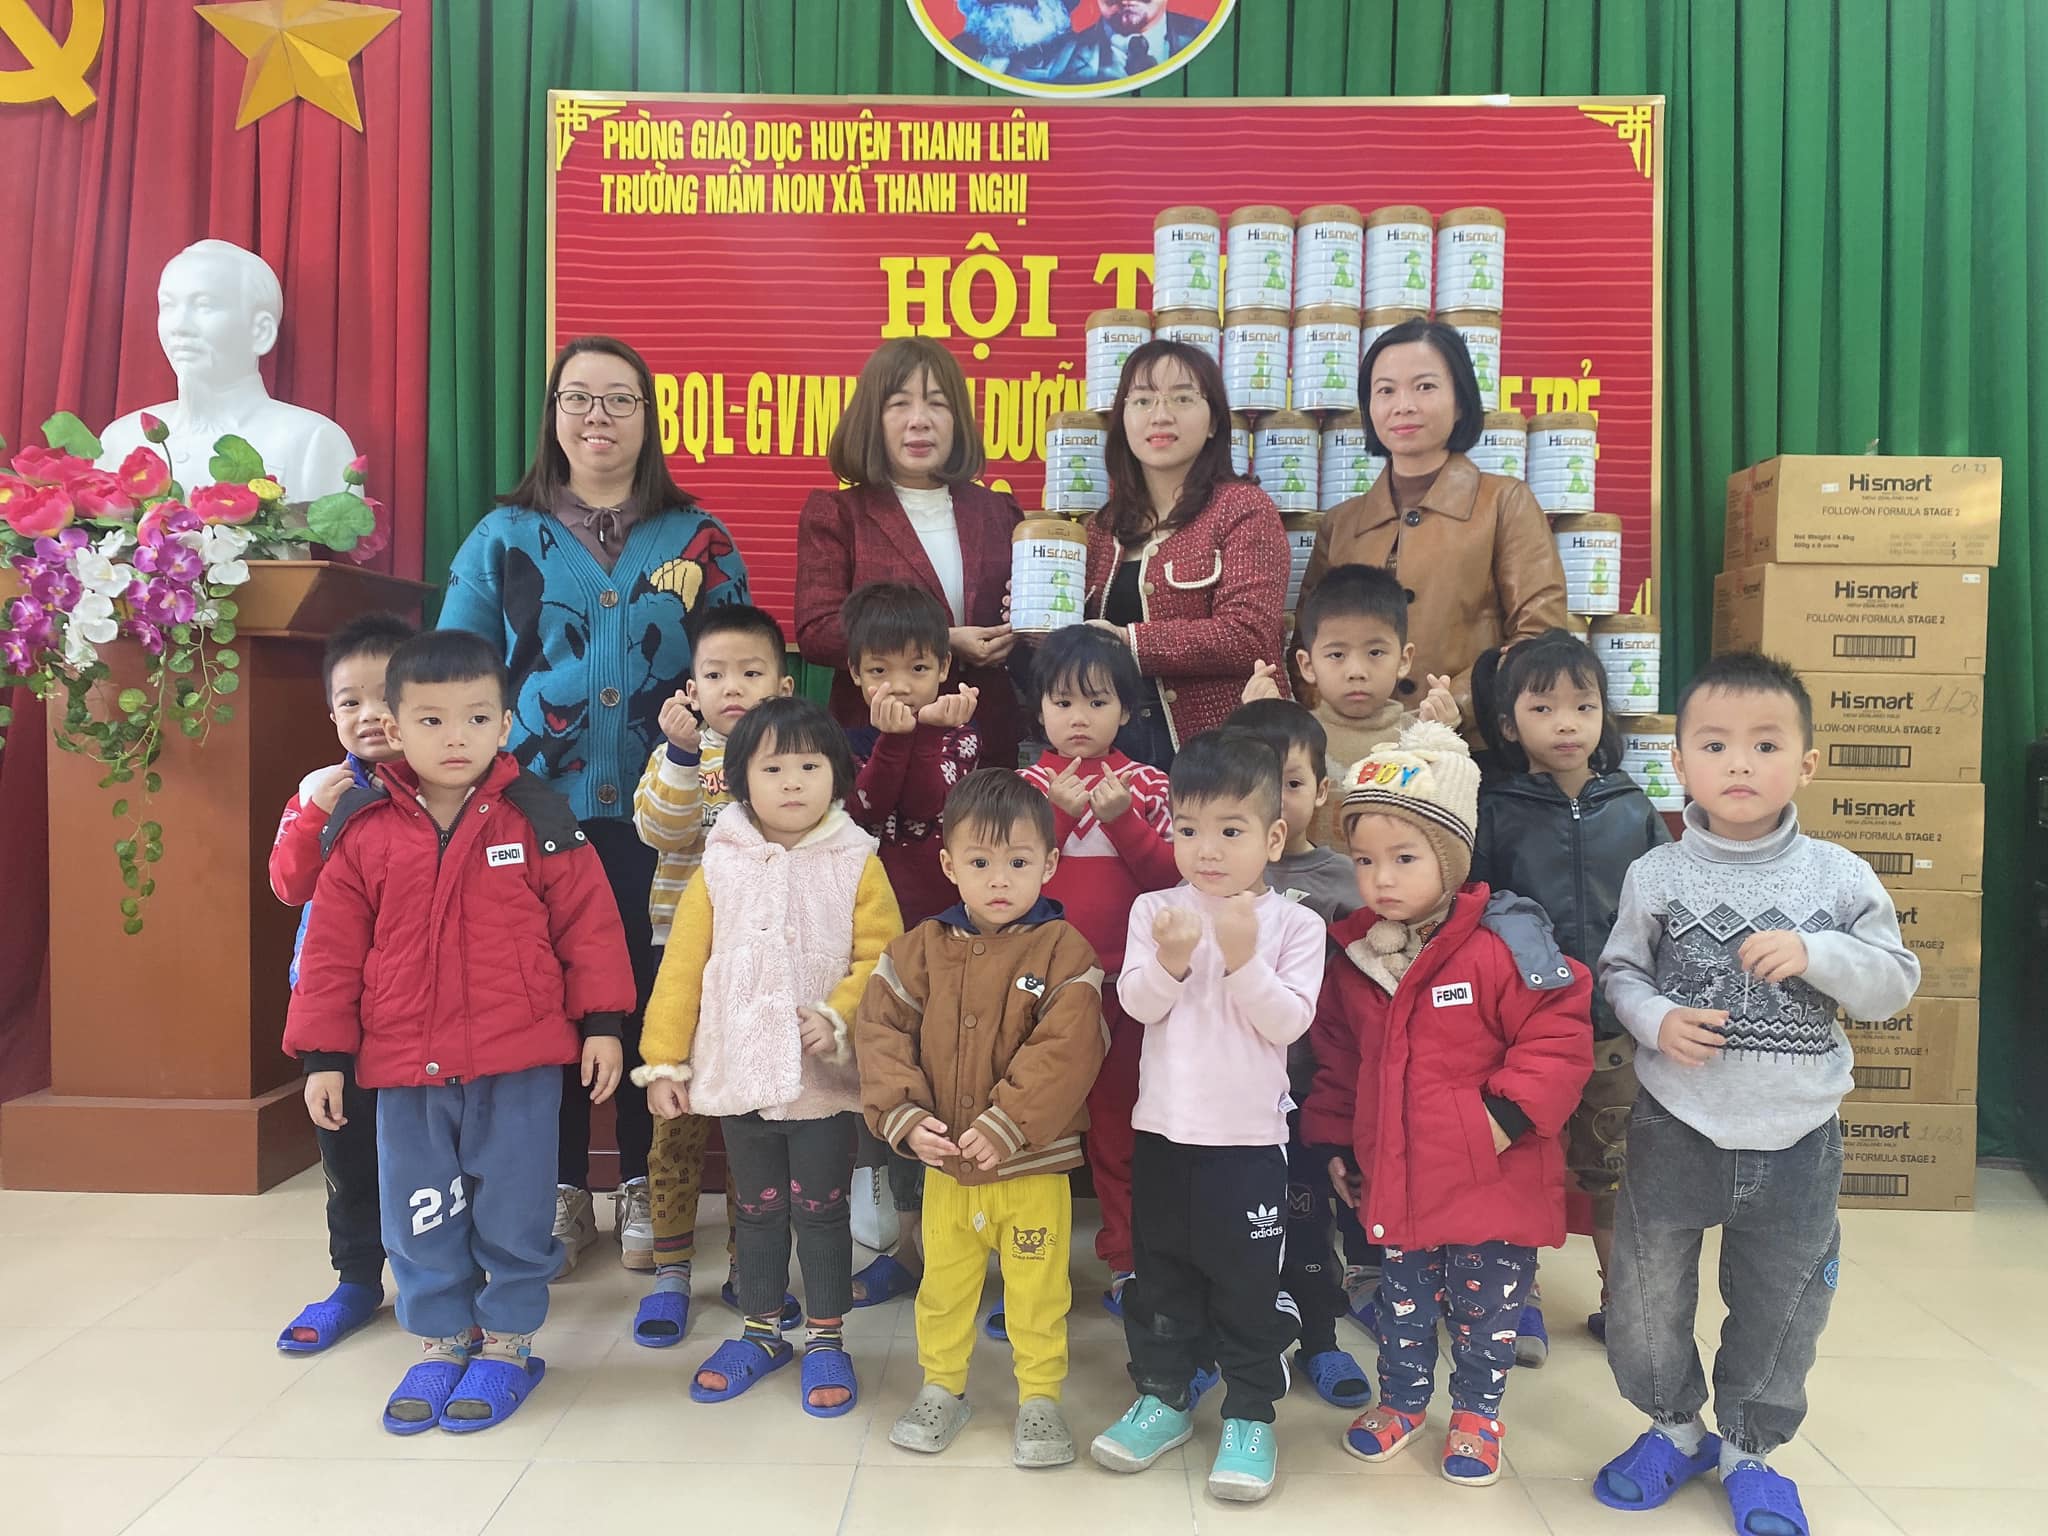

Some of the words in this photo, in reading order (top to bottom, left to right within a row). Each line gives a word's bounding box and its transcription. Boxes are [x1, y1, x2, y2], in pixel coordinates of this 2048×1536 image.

[603, 108, 684, 160] PHÒNG
[691, 110, 747, 160] GIÁO
[754, 121, 803, 169] DỤC
[811, 108, 891, 169] HUYỆN
[898, 121, 981, 161] THANH
[989, 107, 1049, 161] LIÊM
[600, 160, 699, 214] TRƯỜNG
[772, 174, 825, 214] NON
[830, 163, 866, 213] XÃ
[873, 173, 956, 213] THANH
[968, 173, 1028, 226] NGHỊ
[879, 232, 1059, 360] HỘI
[1878, 507, 1921, 516] FORMULA
[1923, 507, 1953, 517] STAGE
[1861, 614, 1905, 624] FORMULA
[1907, 615, 1937, 624] STAGE
[1939, 616, 1945, 624] 2
[1857, 725, 1900, 734] FORMULA
[1903, 725, 1933, 735] STAGE
[1935, 726, 1941, 735] 2
[1357, 762, 1420, 788] BOY
[1859, 831, 1902, 841] FORMULA
[1905, 833, 1935, 842] STAGE
[1937, 833, 1942, 842] 2
[491, 848, 521, 862] FENDI
[1909, 940, 1937, 949] STAGE
[1436, 987, 1468, 1003] FENDI
[1854, 1046, 1890, 1055] ORMULA
[1894, 1047, 1922, 1056] STAGE
[1855, 1153, 1898, 1162] FORMULA
[1900, 1154, 1929, 1163] STAGE
[1931, 1155, 1936, 1164] 2
[409, 1175, 467, 1236] 21
[1250, 1225, 1283, 1240] adidas
